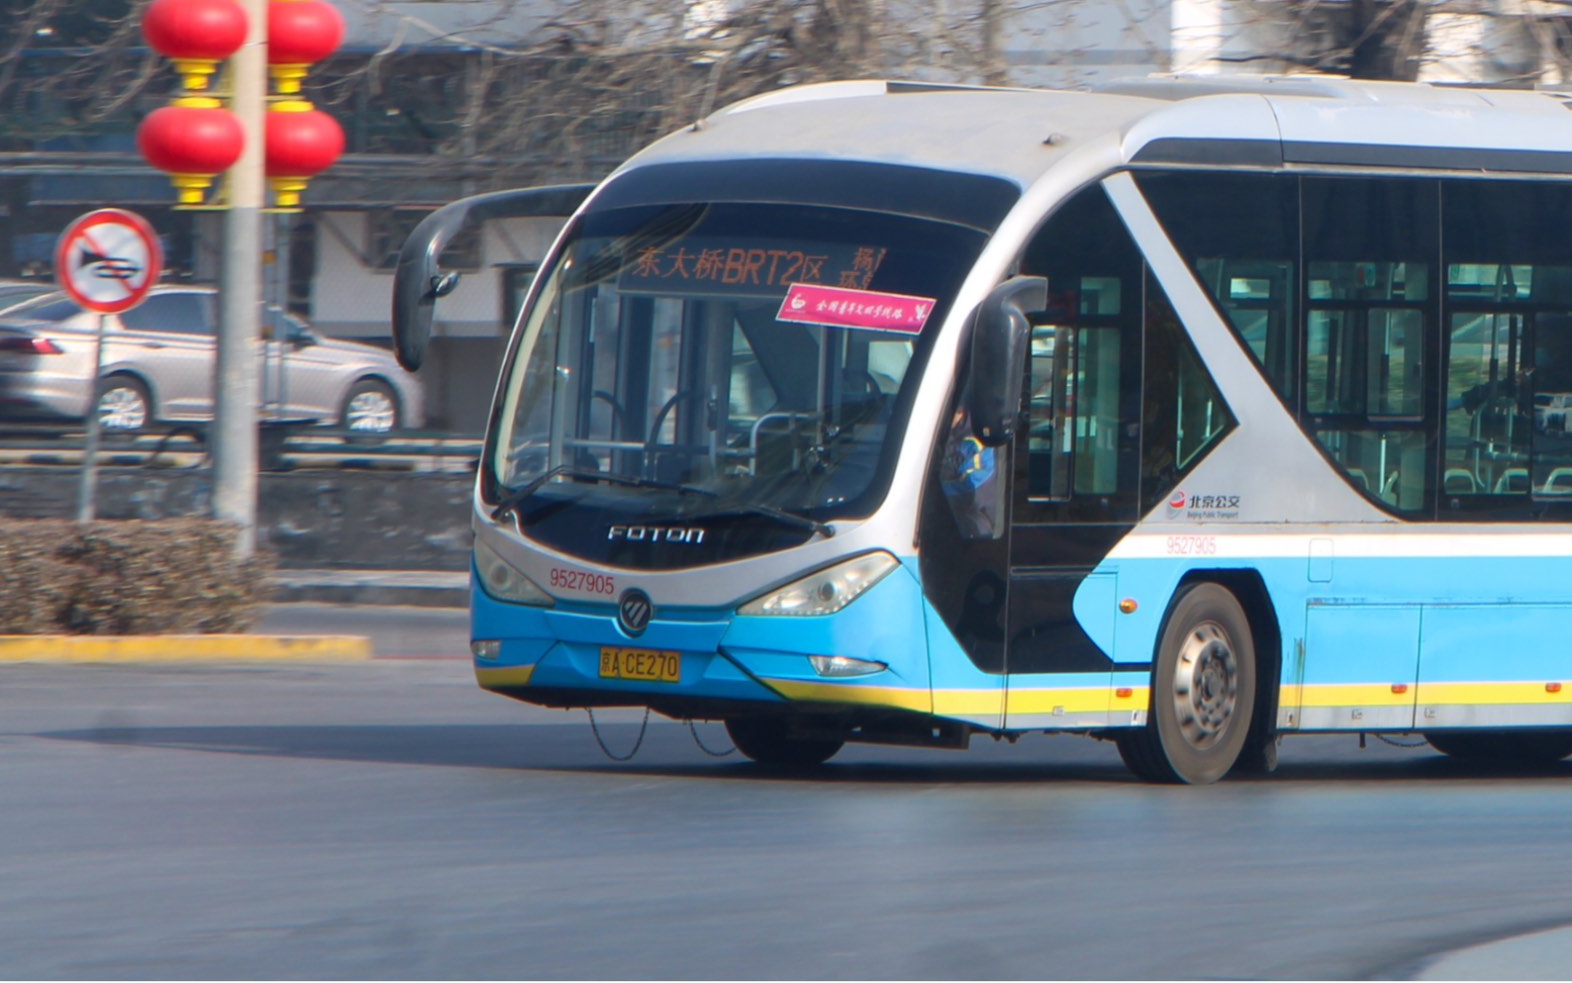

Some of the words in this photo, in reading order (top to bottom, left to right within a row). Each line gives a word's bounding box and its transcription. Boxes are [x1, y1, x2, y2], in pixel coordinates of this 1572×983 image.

[632, 246, 829, 286] 东大桥BRT2区
[1188, 495, 1240, 509] 北京公交
[608, 525, 704, 544] FOTON
[1167, 536, 1217, 555] 9527905
[551, 568, 615, 595] 9527905
